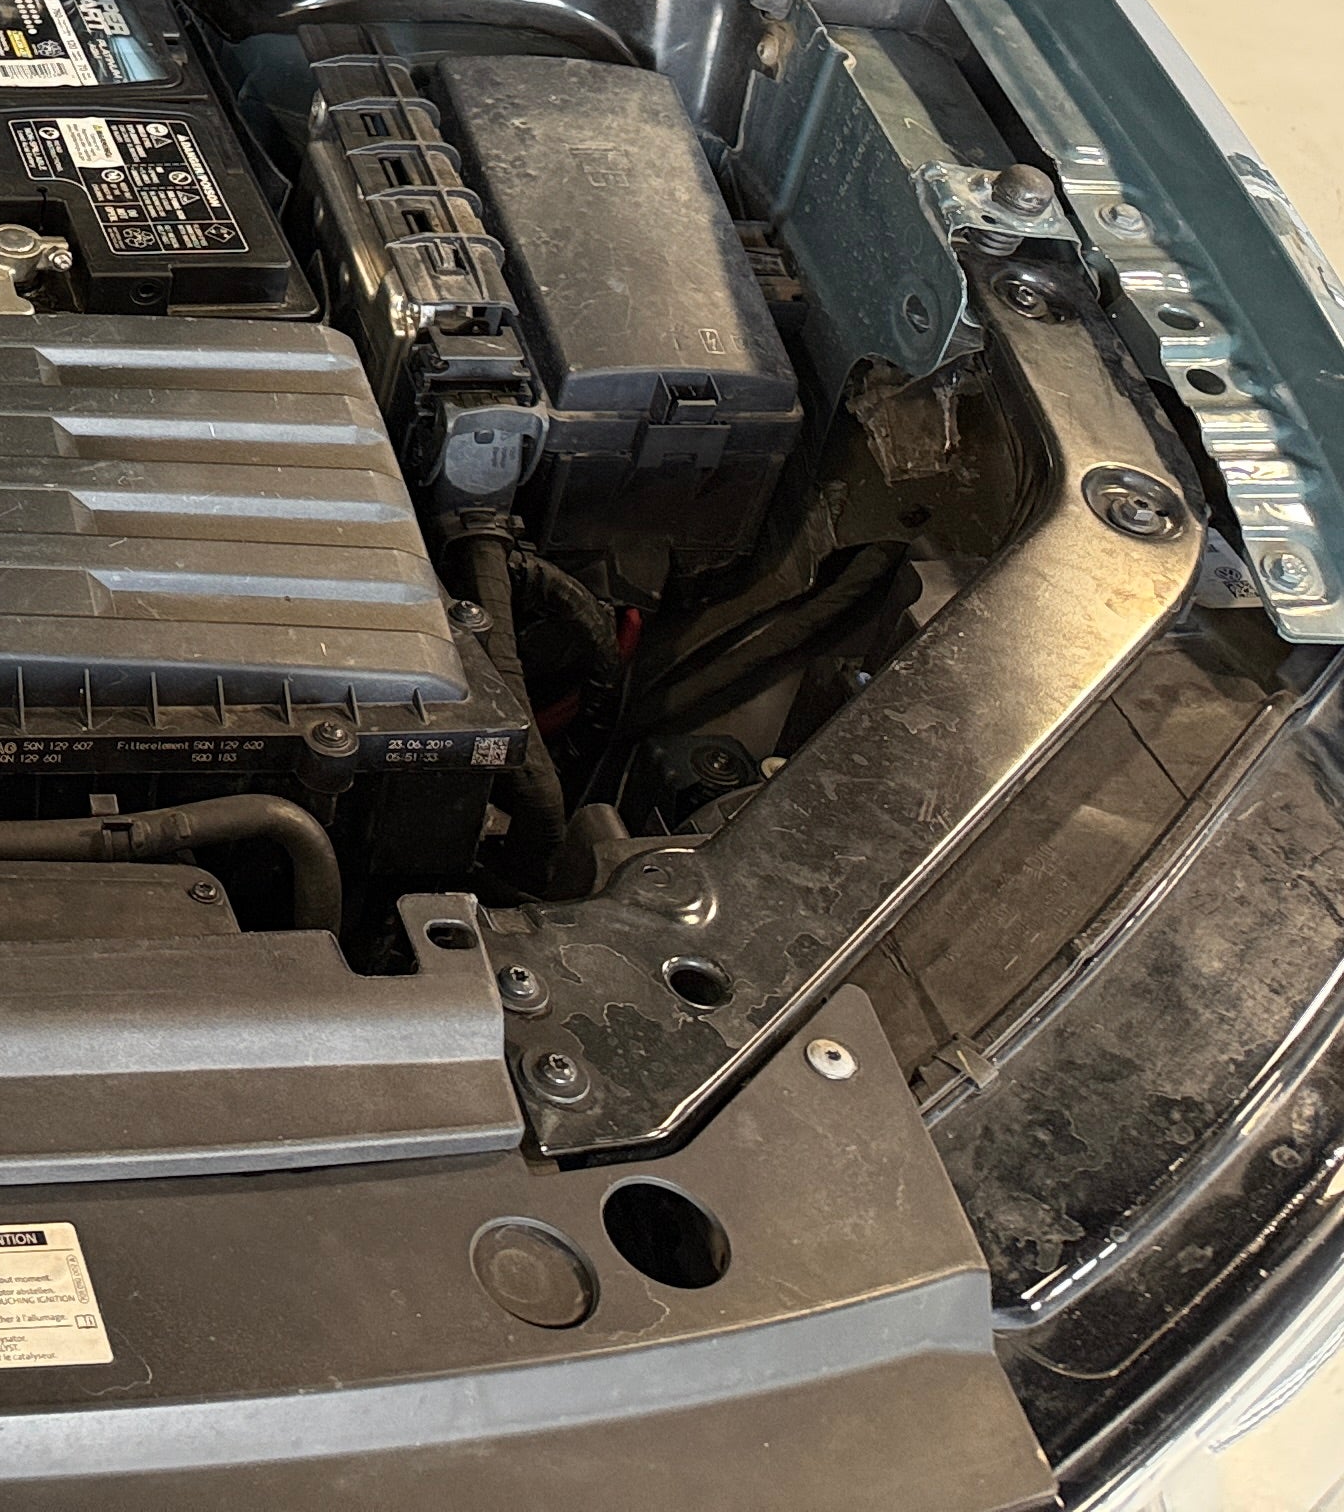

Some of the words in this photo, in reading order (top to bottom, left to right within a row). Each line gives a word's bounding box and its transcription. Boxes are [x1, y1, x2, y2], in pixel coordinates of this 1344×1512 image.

[96, 38, 124, 79] PLATINUM
[50, 741, 68, 751] 129
[73, 741, 93, 751] 607
[220, 740, 238, 750] 129
[244, 740, 263, 749] 620
[20, 754, 38, 763] 129
[43, 754, 61, 763] 601
[218, 753, 236, 762] 183
